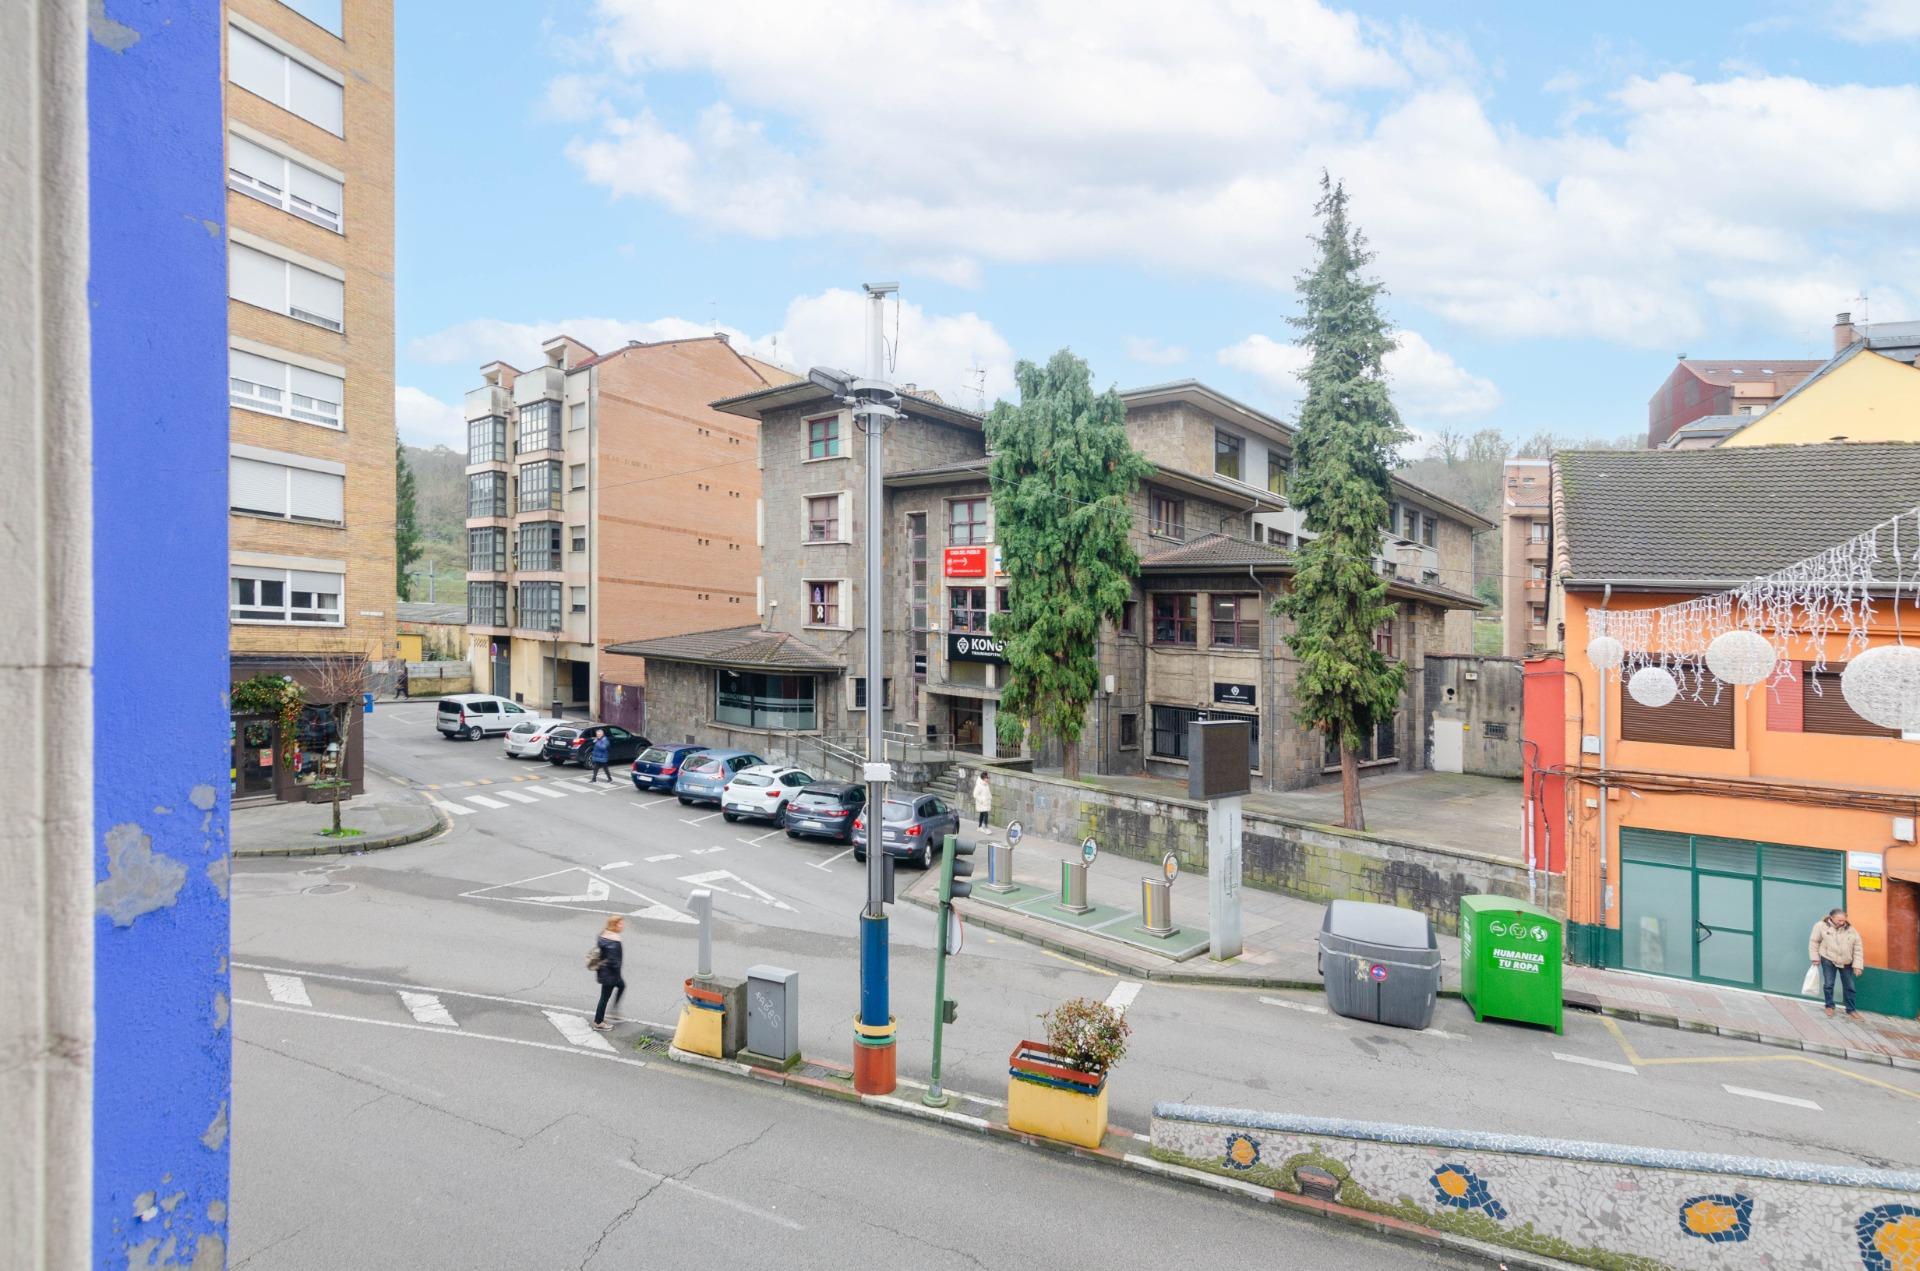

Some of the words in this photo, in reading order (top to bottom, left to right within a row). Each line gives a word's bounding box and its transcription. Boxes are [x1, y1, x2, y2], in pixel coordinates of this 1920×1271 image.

[1493, 948, 1544, 963] HUMANIZA
[1499, 959, 1512, 968] TU
[1513, 961, 1539, 972] ROPA
